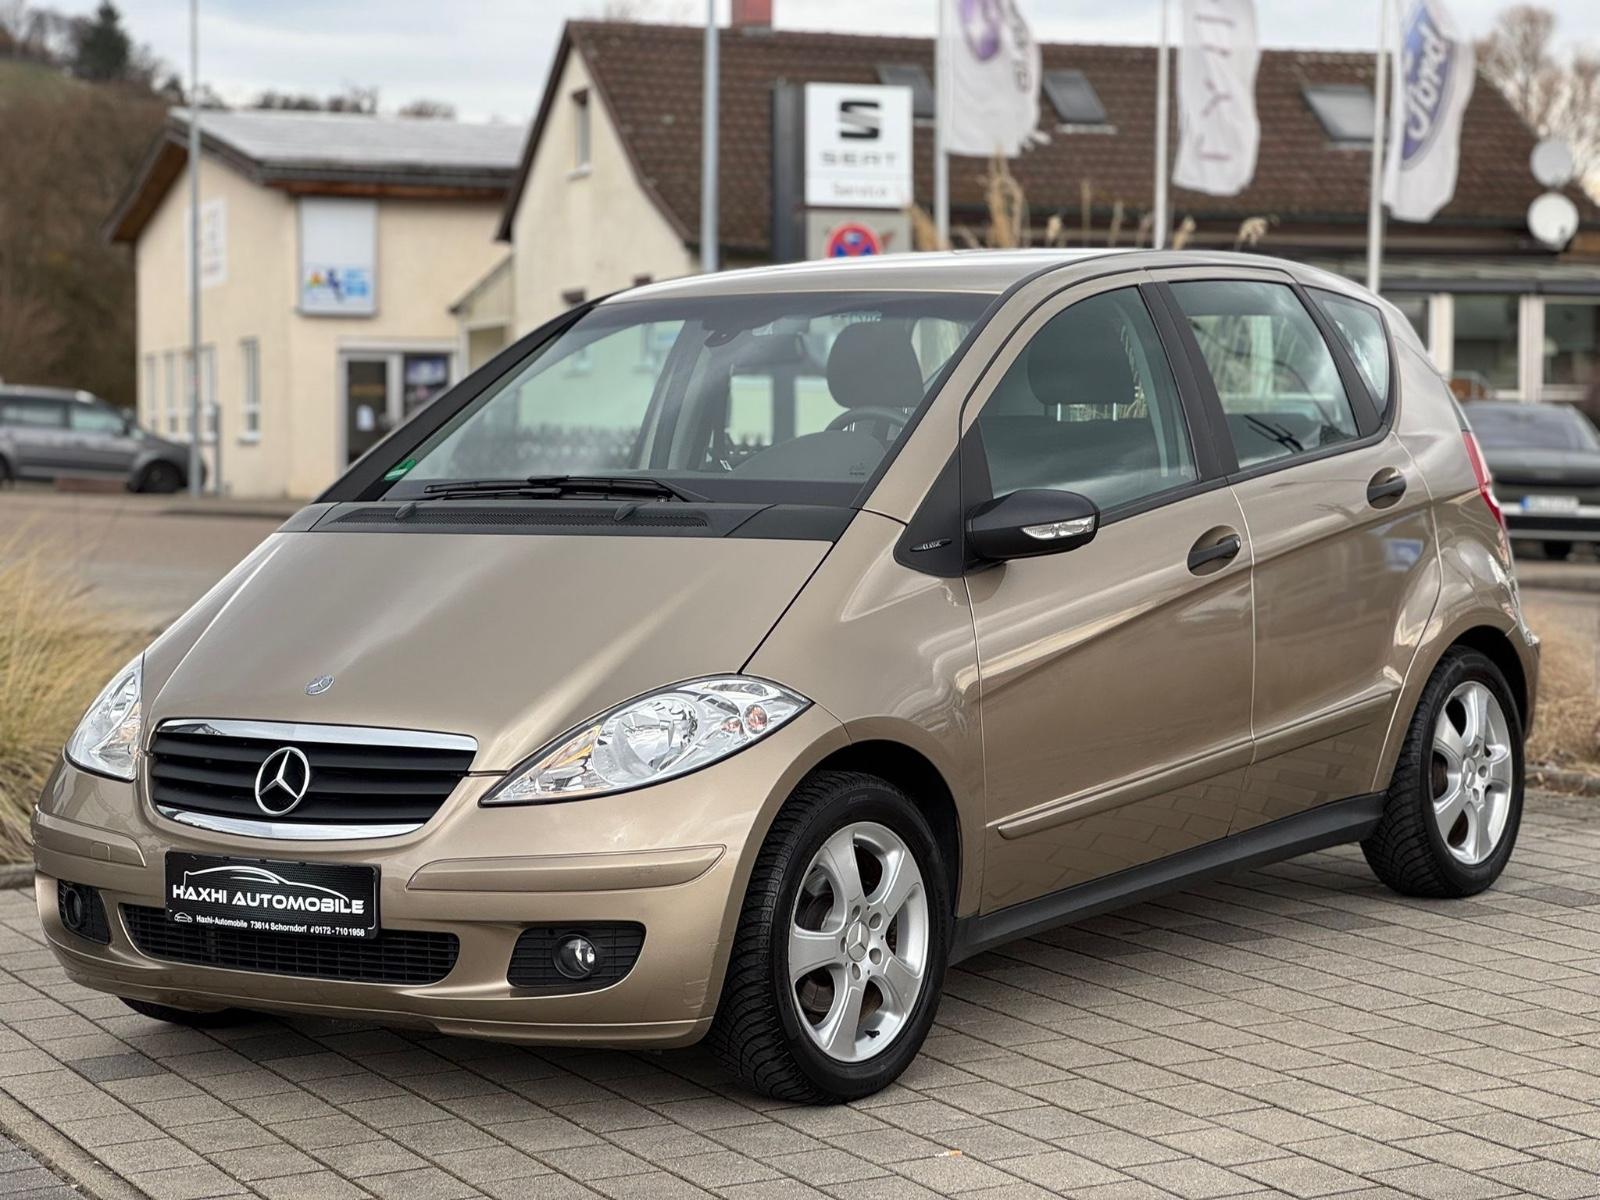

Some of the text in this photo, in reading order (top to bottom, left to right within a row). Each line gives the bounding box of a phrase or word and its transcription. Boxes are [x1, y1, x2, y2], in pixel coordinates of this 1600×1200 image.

[172, 884, 365, 915] HAXHI AUTOMOBILE
[196, 914, 248, 929] Haxhi-Automobile
[270, 922, 307, 933] Schorndorf
